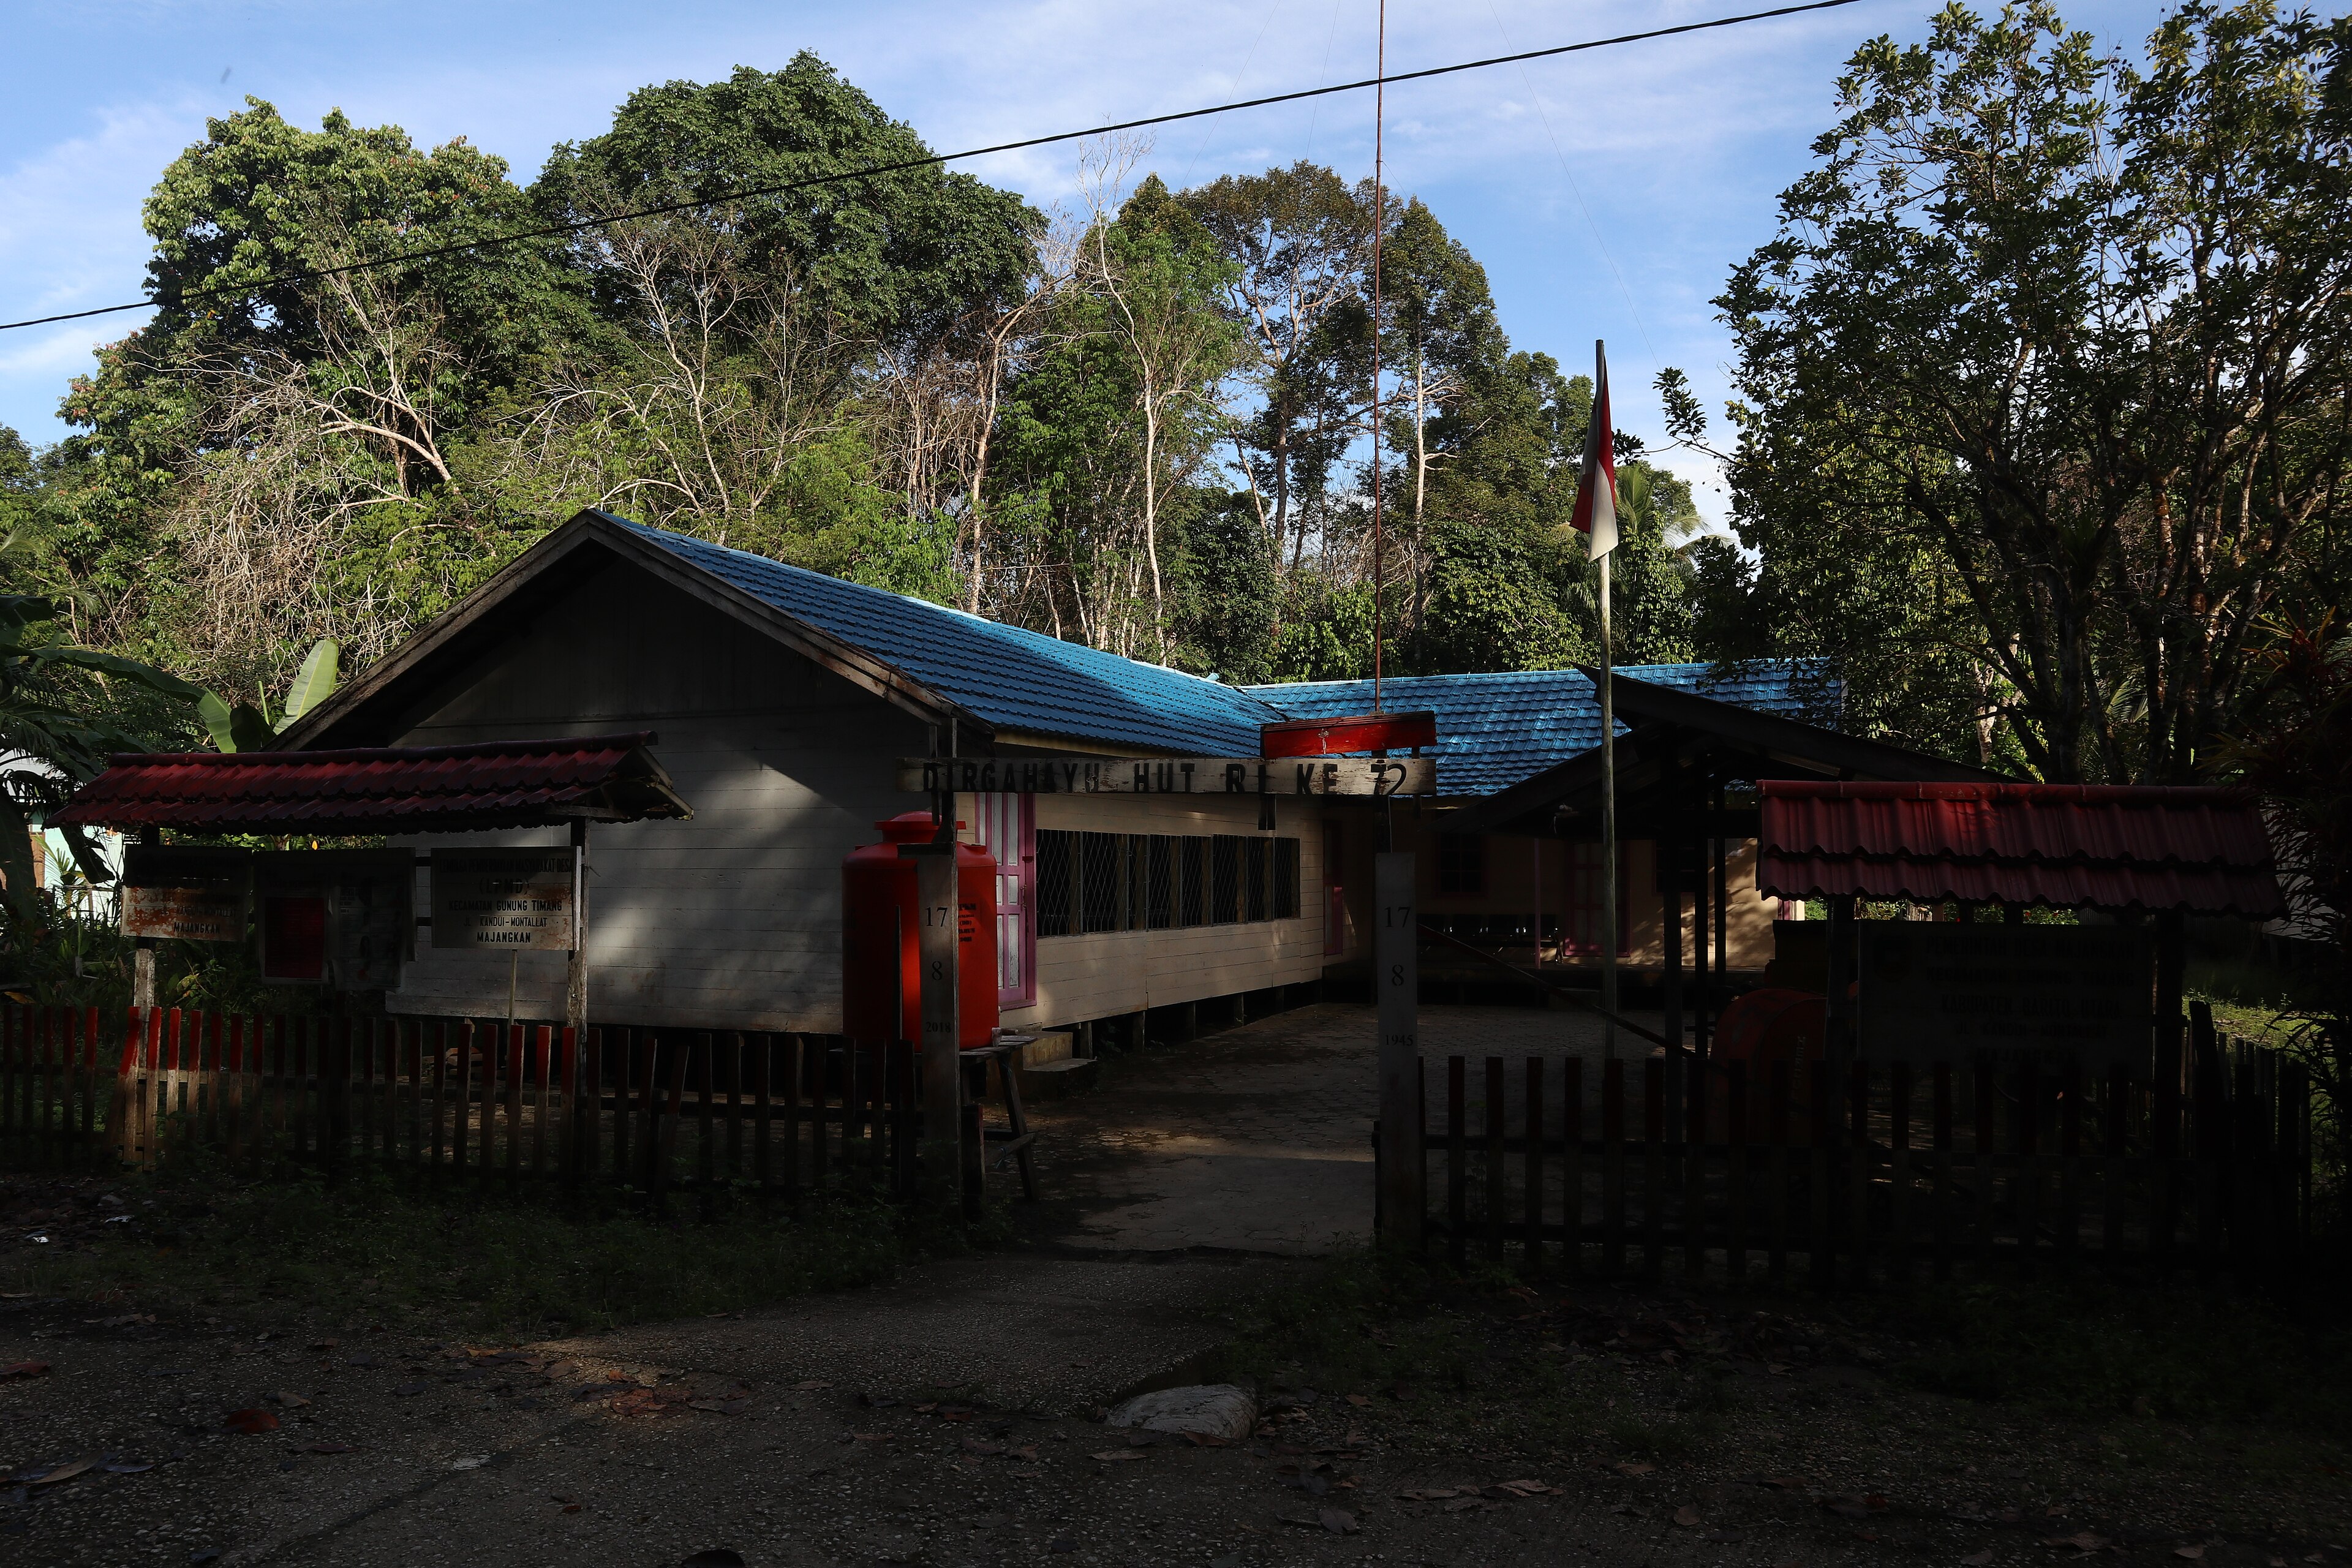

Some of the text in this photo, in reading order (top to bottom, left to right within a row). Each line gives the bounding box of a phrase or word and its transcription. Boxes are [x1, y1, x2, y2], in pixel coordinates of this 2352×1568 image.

[923, 763, 1407, 795] DIRGAHAYU HUT RI KE 72
[557, 858, 573, 873] DESA
[448, 900, 562, 911] KECAMATAN GUNUNG TIMANG
[925, 907, 948, 927] 17
[1384, 906, 1411, 927] 17
[174, 922, 221, 935] MAJANGKAN
[477, 931, 531, 944] MAJANGKAN
[1926, 935, 2007, 957] PEMERINTAH
[2014, 937, 2048, 958] DESA
[931, 960, 943, 981] 8
[1392, 964, 1404, 986] 8
[1941, 994, 2013, 1015] KABUPATEN
[2080, 1000, 2121, 1019] UTARA
[925, 1021, 951, 1033] 2018
[1385, 1034, 1414, 1046] 1945
